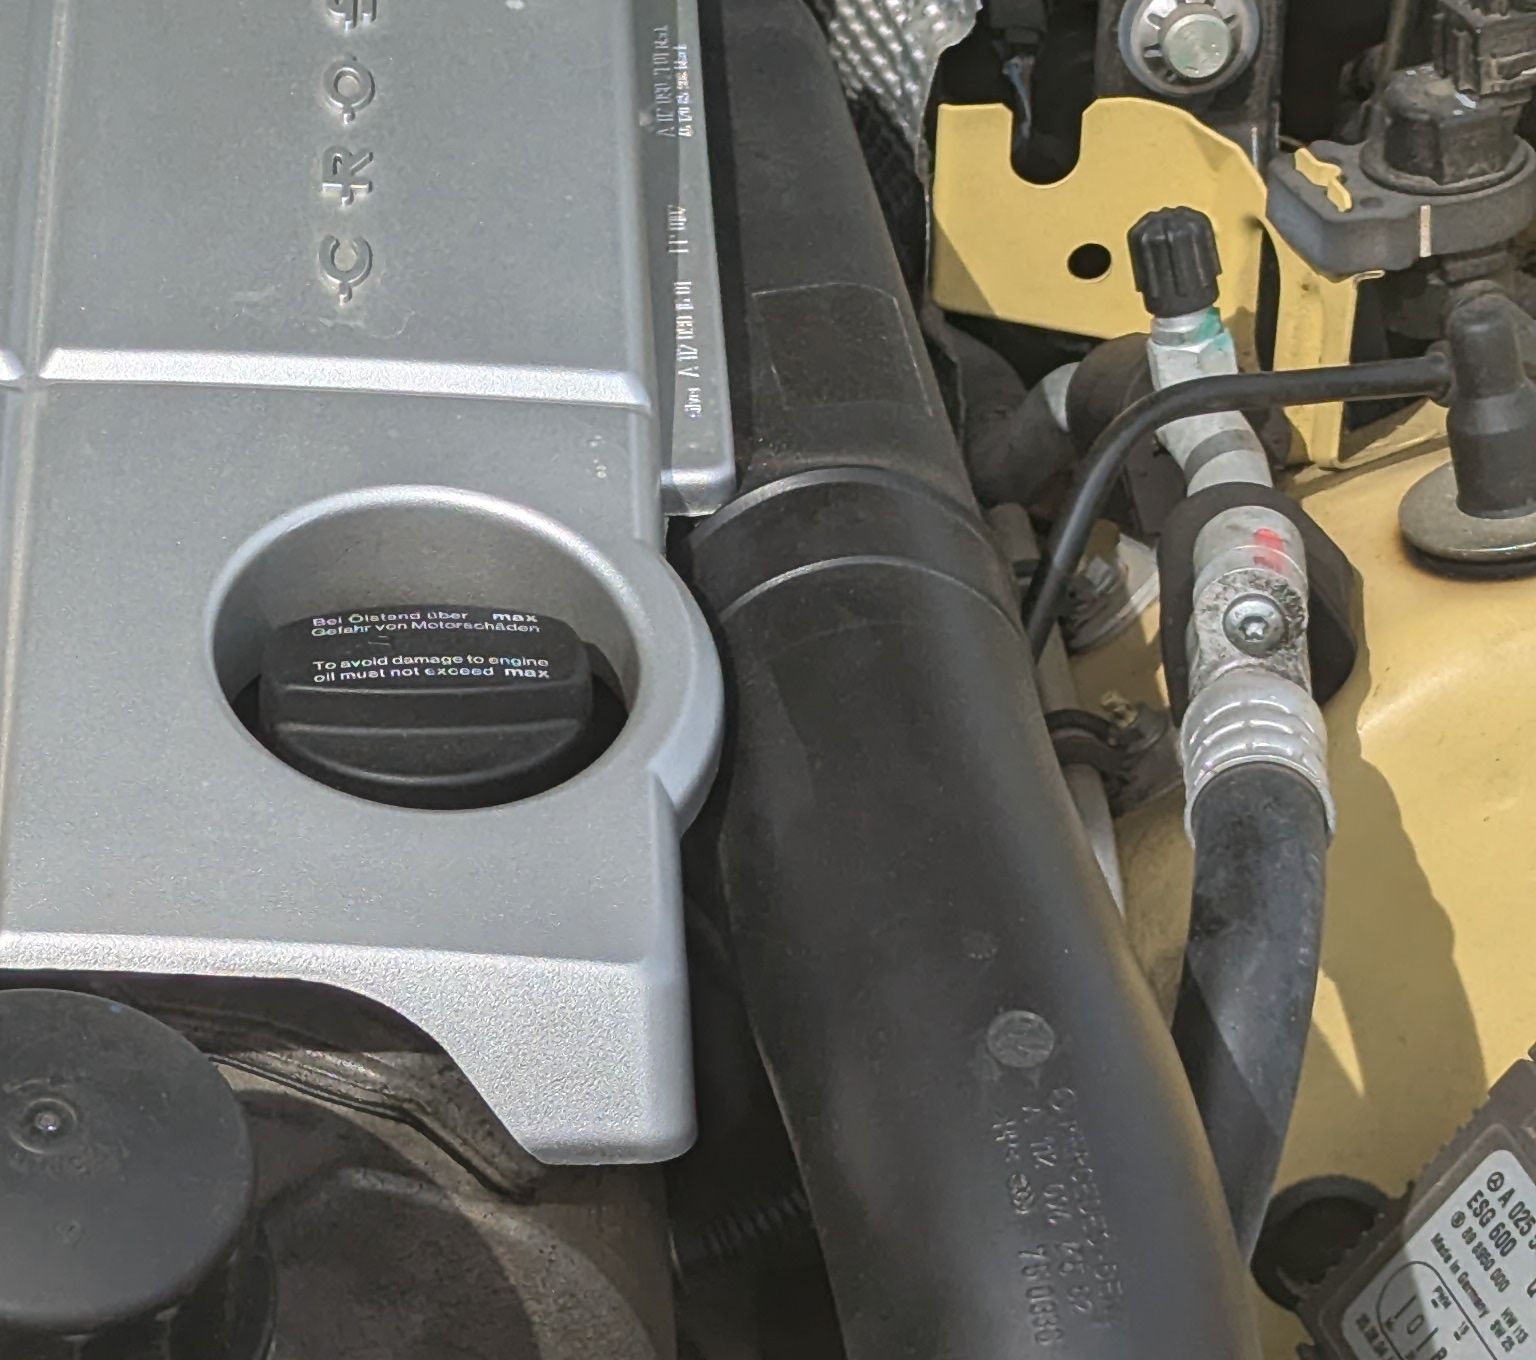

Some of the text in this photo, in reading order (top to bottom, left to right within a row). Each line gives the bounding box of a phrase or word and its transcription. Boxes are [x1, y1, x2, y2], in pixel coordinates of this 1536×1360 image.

[312, 616, 343, 627] Bei
[427, 611, 468, 620] über
[493, 613, 538, 623] max
[311, 620, 541, 637] Gefahr von Motorschäden
[313, 654, 549, 670] To avoid damage to engine
[314, 666, 550, 683] oil must not exceed max
[1498, 1188, 1536, 1237] A 025
[1467, 1190, 1517, 1257] ESG 600
[1430, 1232, 1490, 1319] Made in Germany
